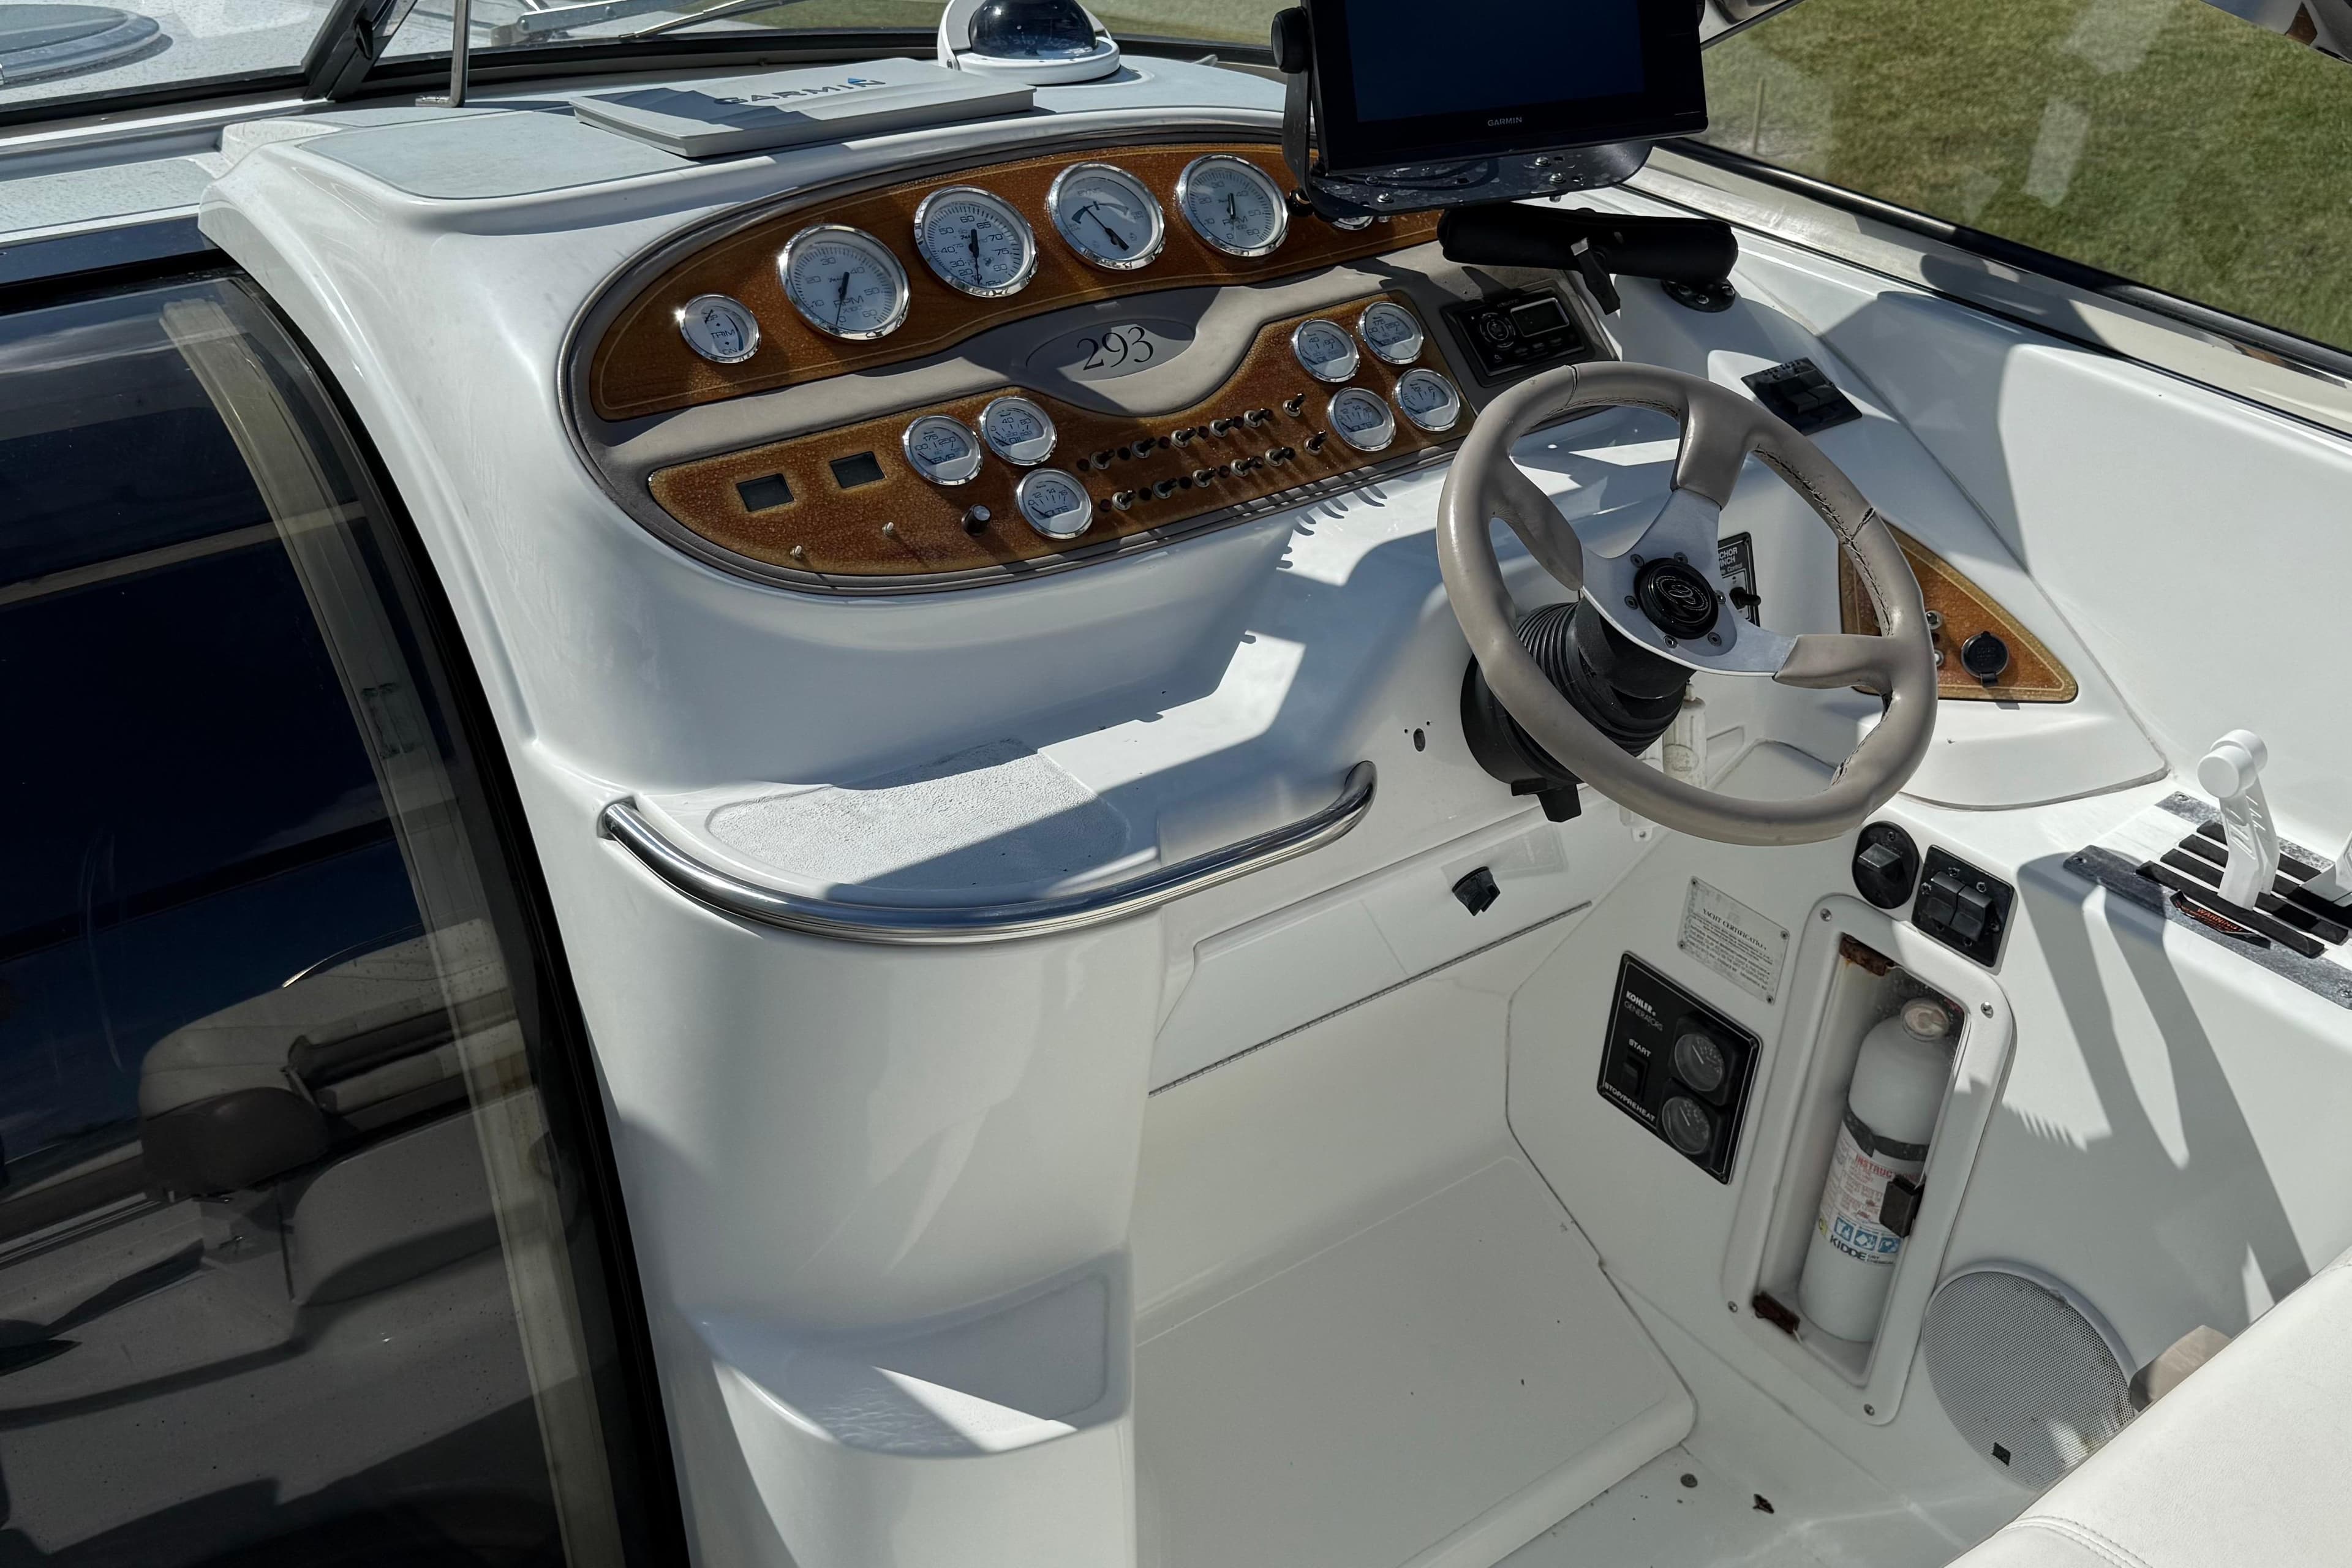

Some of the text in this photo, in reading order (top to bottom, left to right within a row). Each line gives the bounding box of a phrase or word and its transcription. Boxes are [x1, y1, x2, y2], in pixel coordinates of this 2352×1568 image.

[714, 78, 886, 105] GARMIN
[1487, 117, 1522, 127] GARMIN
[960, 215, 975, 224] 60
[1222, 216, 1248, 226] RPM
[976, 221, 992, 230] 65
[938, 227, 954, 235] 50
[987, 233, 1003, 242] 70
[993, 247, 1009, 256] 75
[820, 256, 837, 266] 30
[950, 259, 965, 268] 30
[850, 266, 865, 275] 40
[959, 268, 974, 276] 20
[993, 263, 1008, 273] 80
[805, 276, 822, 285] 20
[864, 287, 880, 296] 50
[832, 295, 865, 307] RPM
[862, 309, 878, 318] 60
[710, 329, 736, 339] TRIM
[1077, 326, 1154, 371] 293
[1719, 547, 1738, 559] CHOR
[1720, 556, 1736, 567] INCH
[1727, 562, 1743, 572] Control
[1703, 908, 1722, 923] YACHT
[1626, 990, 1653, 1014] KOHLER
[1624, 1000, 1664, 1031] GENERATORS
[1628, 1038, 1652, 1057] START
[1604, 1081, 1656, 1122] STOP/PREHEAT
[1830, 1234, 1867, 1261] KIDDE
